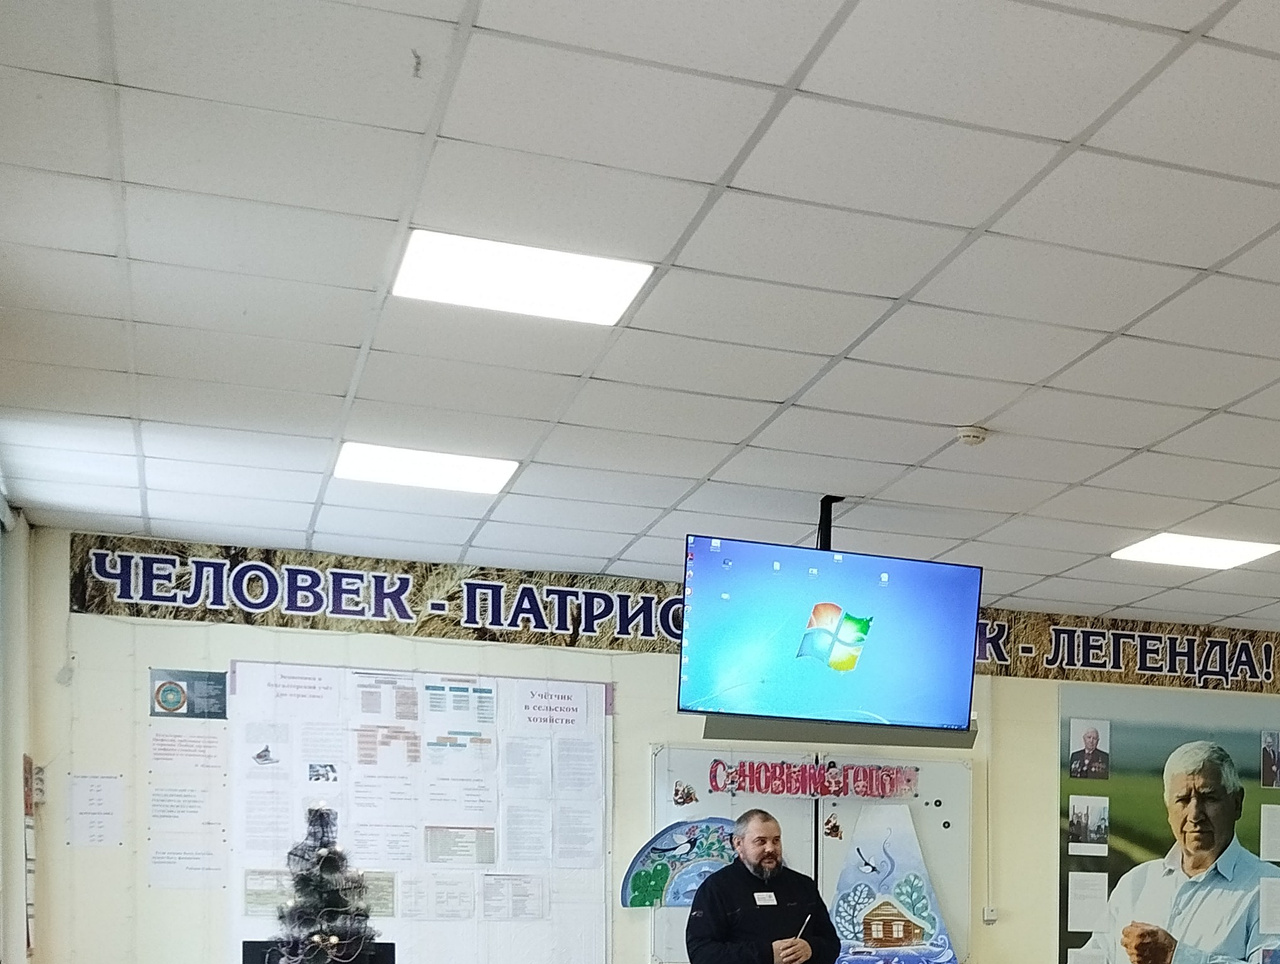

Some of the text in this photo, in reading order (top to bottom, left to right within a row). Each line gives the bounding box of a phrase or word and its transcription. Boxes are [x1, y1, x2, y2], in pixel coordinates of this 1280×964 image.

[90, 550, 415, 622] ЧЕЛОВЕК
[1045, 626, 1274, 687] ЛЕГЕНДА!
[530, 690, 574, 701] Учётчик
[527, 715, 576, 724] хозяйстве
[532, 704, 578, 712] сельском
[709, 760, 727, 793] С
[738, 761, 828, 797] НОВЫМ
